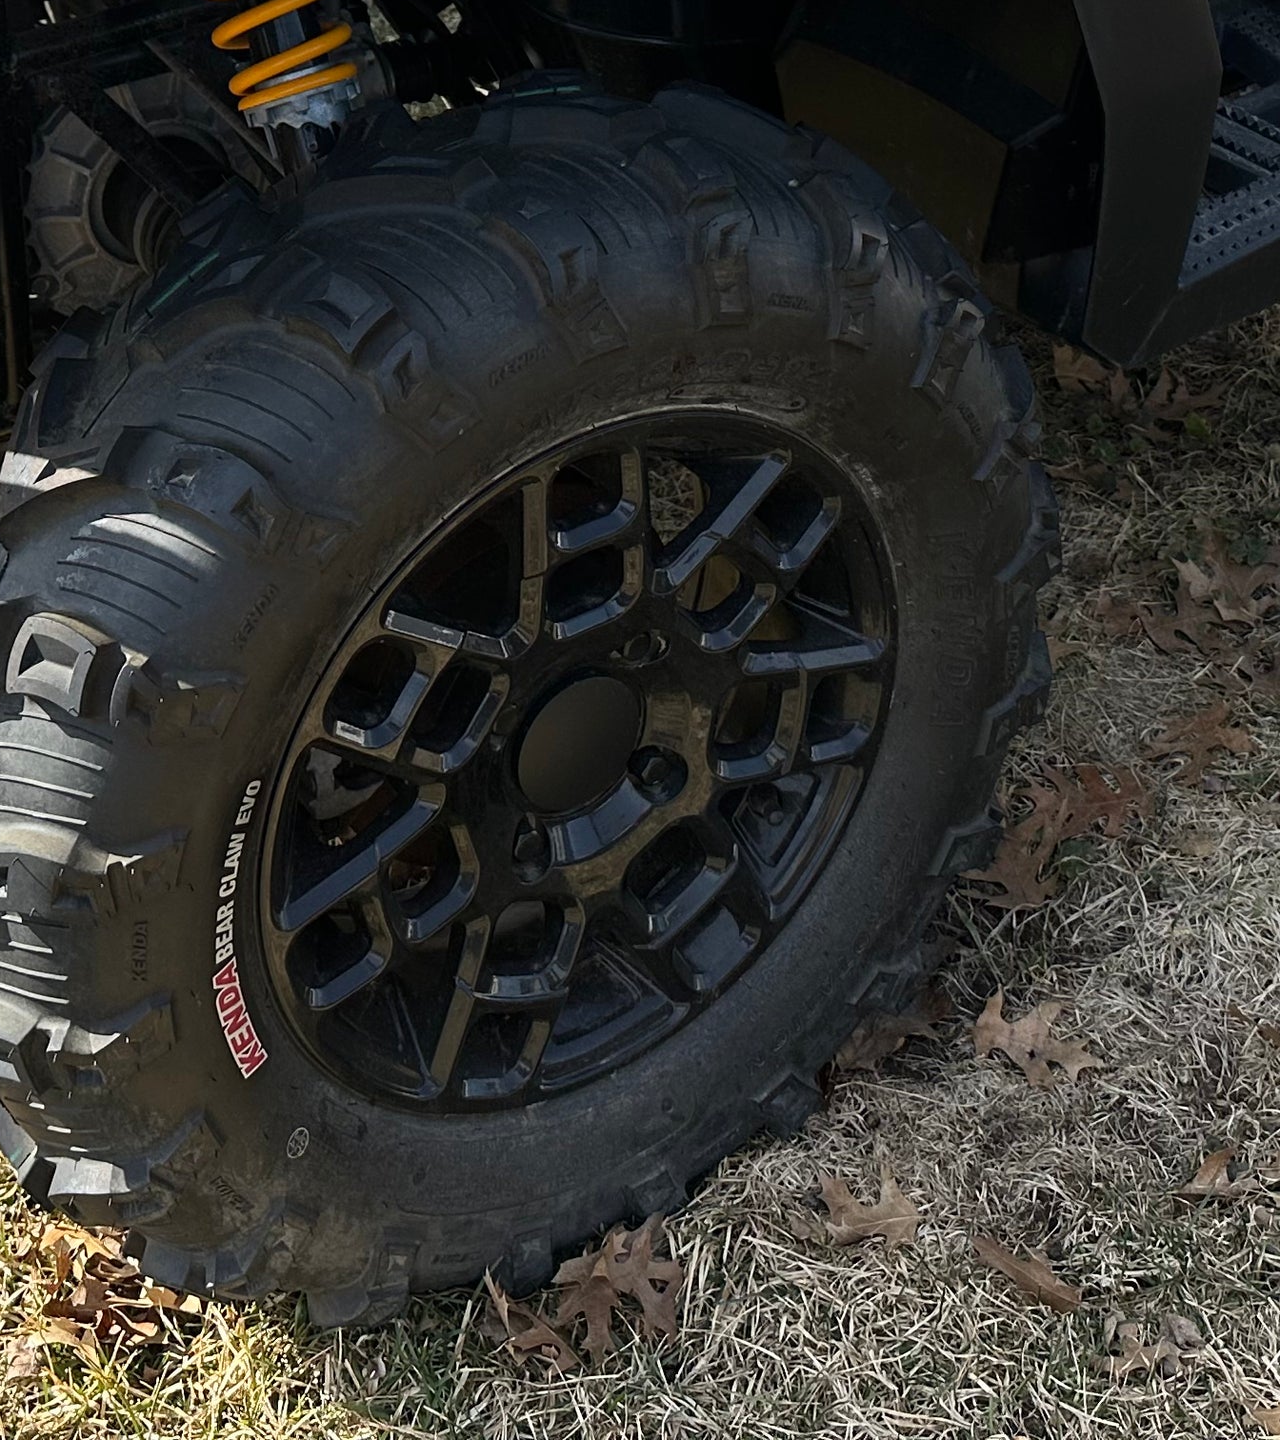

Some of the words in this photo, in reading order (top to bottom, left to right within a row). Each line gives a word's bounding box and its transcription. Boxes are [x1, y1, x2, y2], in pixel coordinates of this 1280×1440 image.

[235, 778, 262, 827] EVO
[218, 833, 246, 898] CLAW
[214, 899, 235, 964] BEAR
[211, 956, 269, 1079] KENDA
